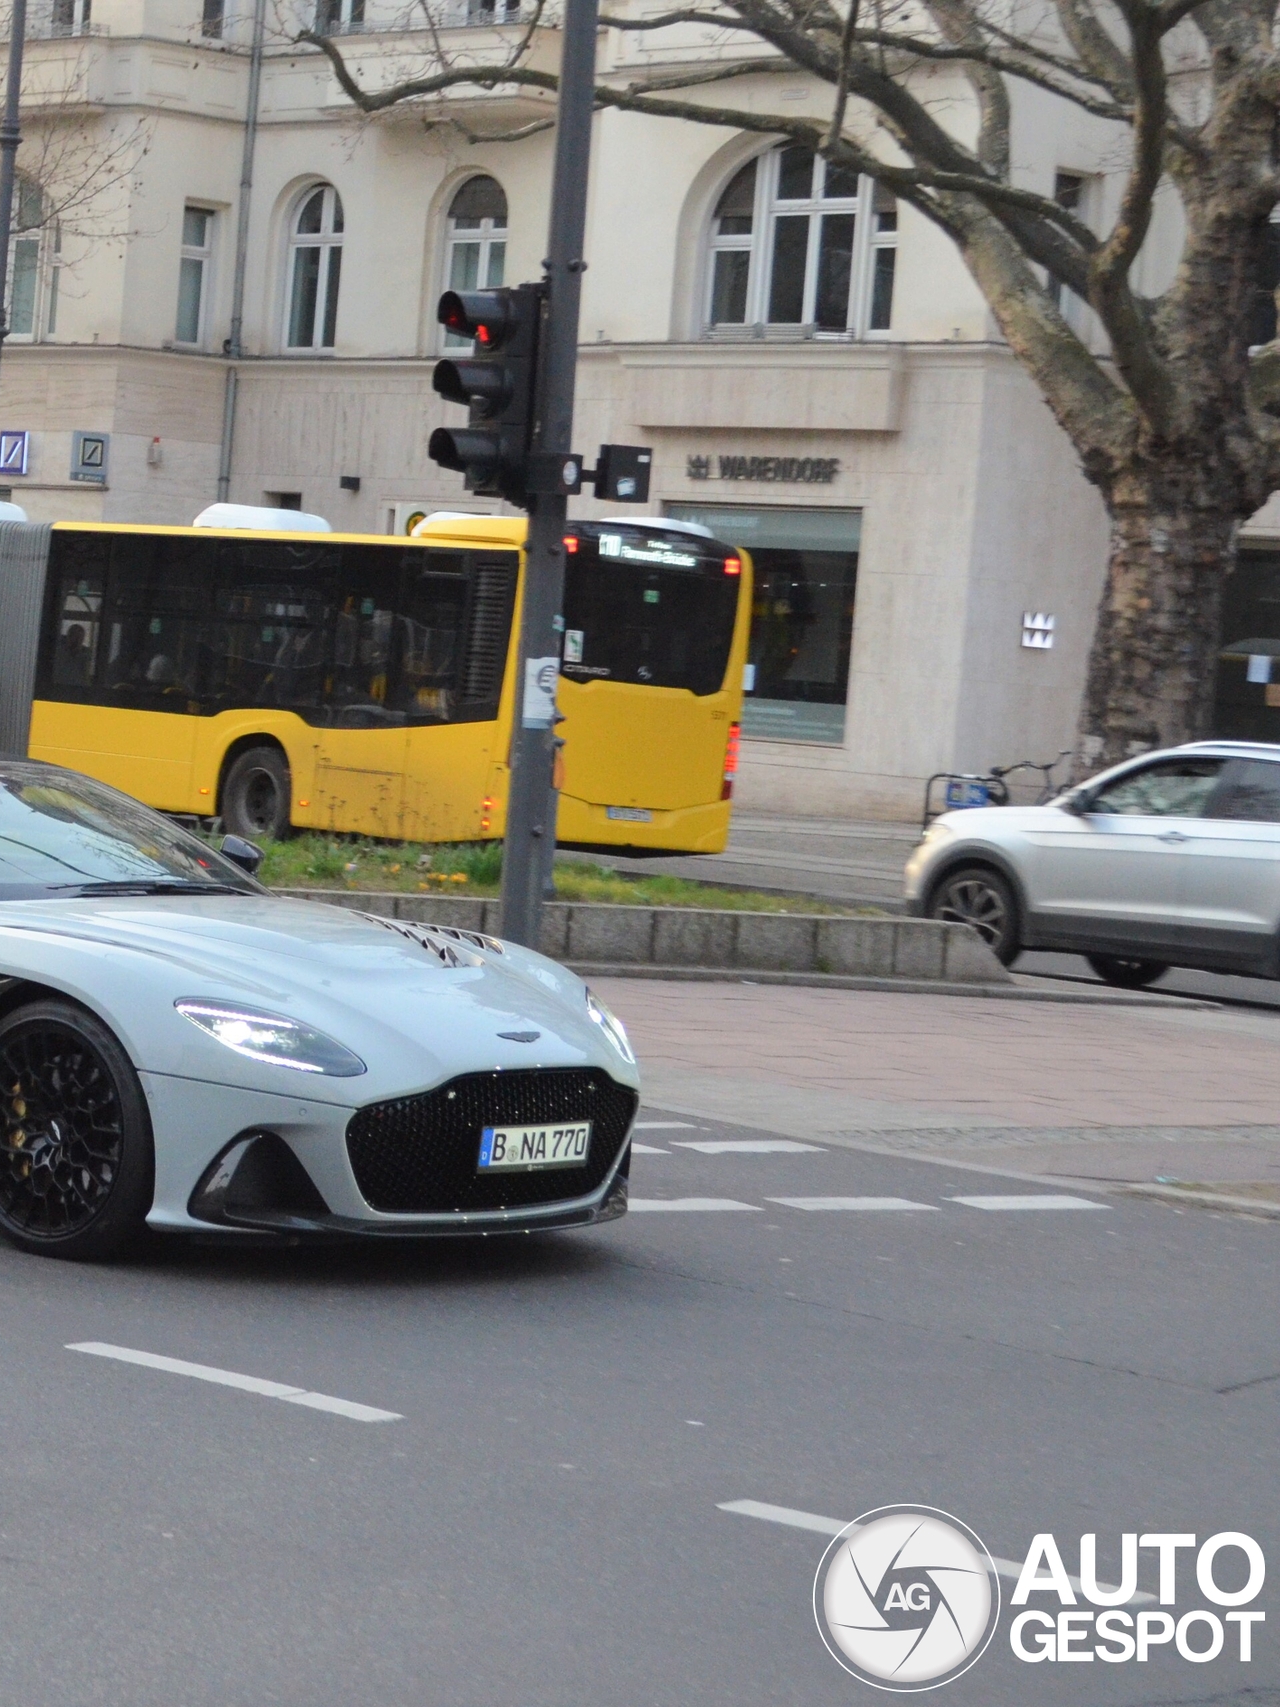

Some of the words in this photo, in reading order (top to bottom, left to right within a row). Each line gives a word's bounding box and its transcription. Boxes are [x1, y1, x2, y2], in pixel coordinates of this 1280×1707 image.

[719, 455, 840, 483] WARENDORF
[491, 1133, 507, 1162] B
[520, 1131, 546, 1160] NA
[552, 1128, 586, 1158] 770
